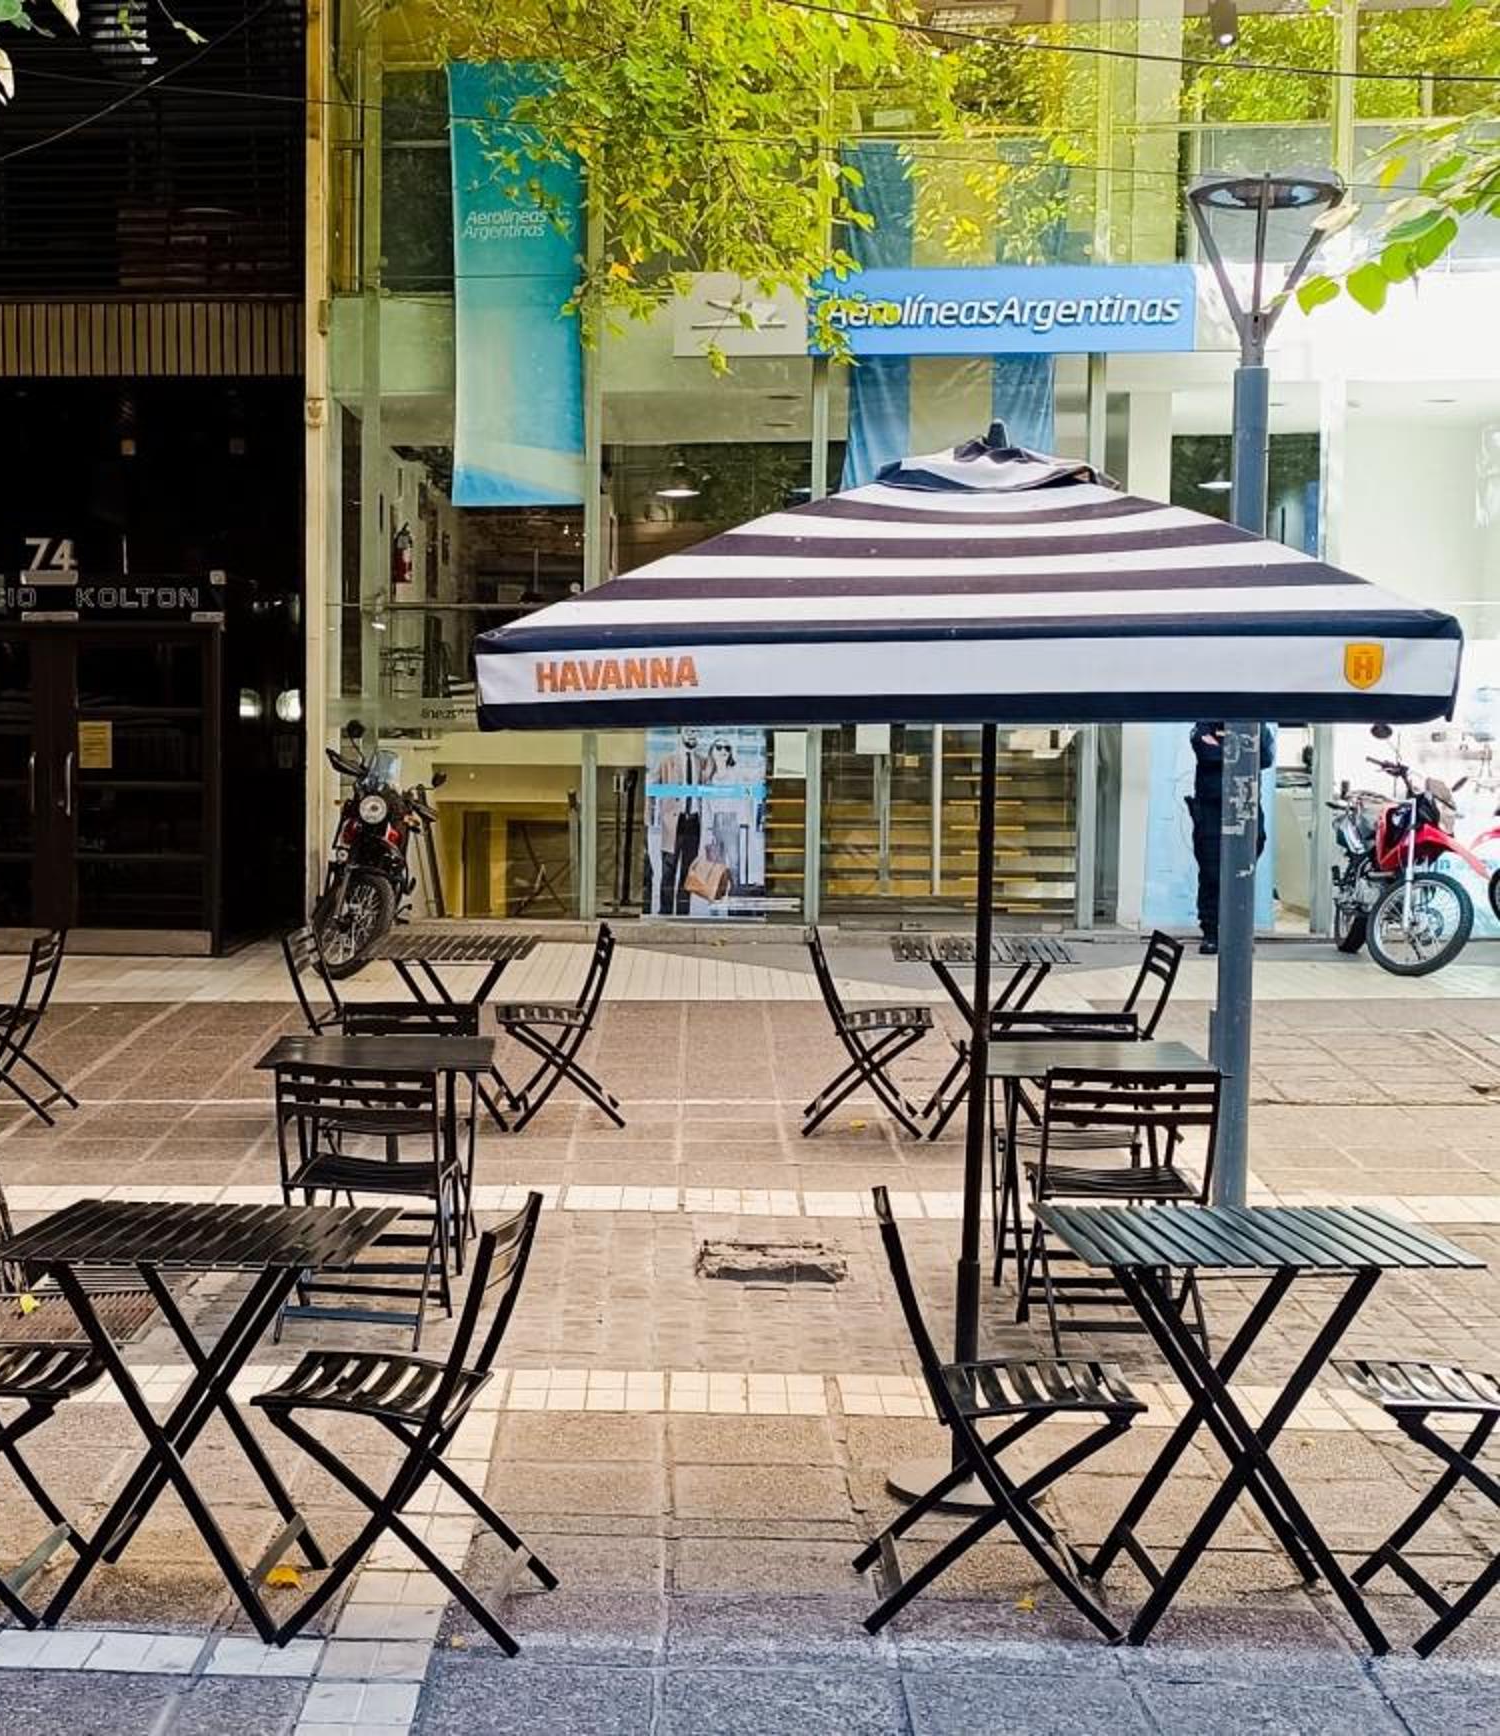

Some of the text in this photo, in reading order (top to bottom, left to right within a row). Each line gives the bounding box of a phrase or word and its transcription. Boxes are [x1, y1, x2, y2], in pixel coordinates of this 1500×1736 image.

[25, 537, 77, 571] 74
[75, 587, 199, 609] KOLTON
[536, 655, 699, 693] HAVANNA
